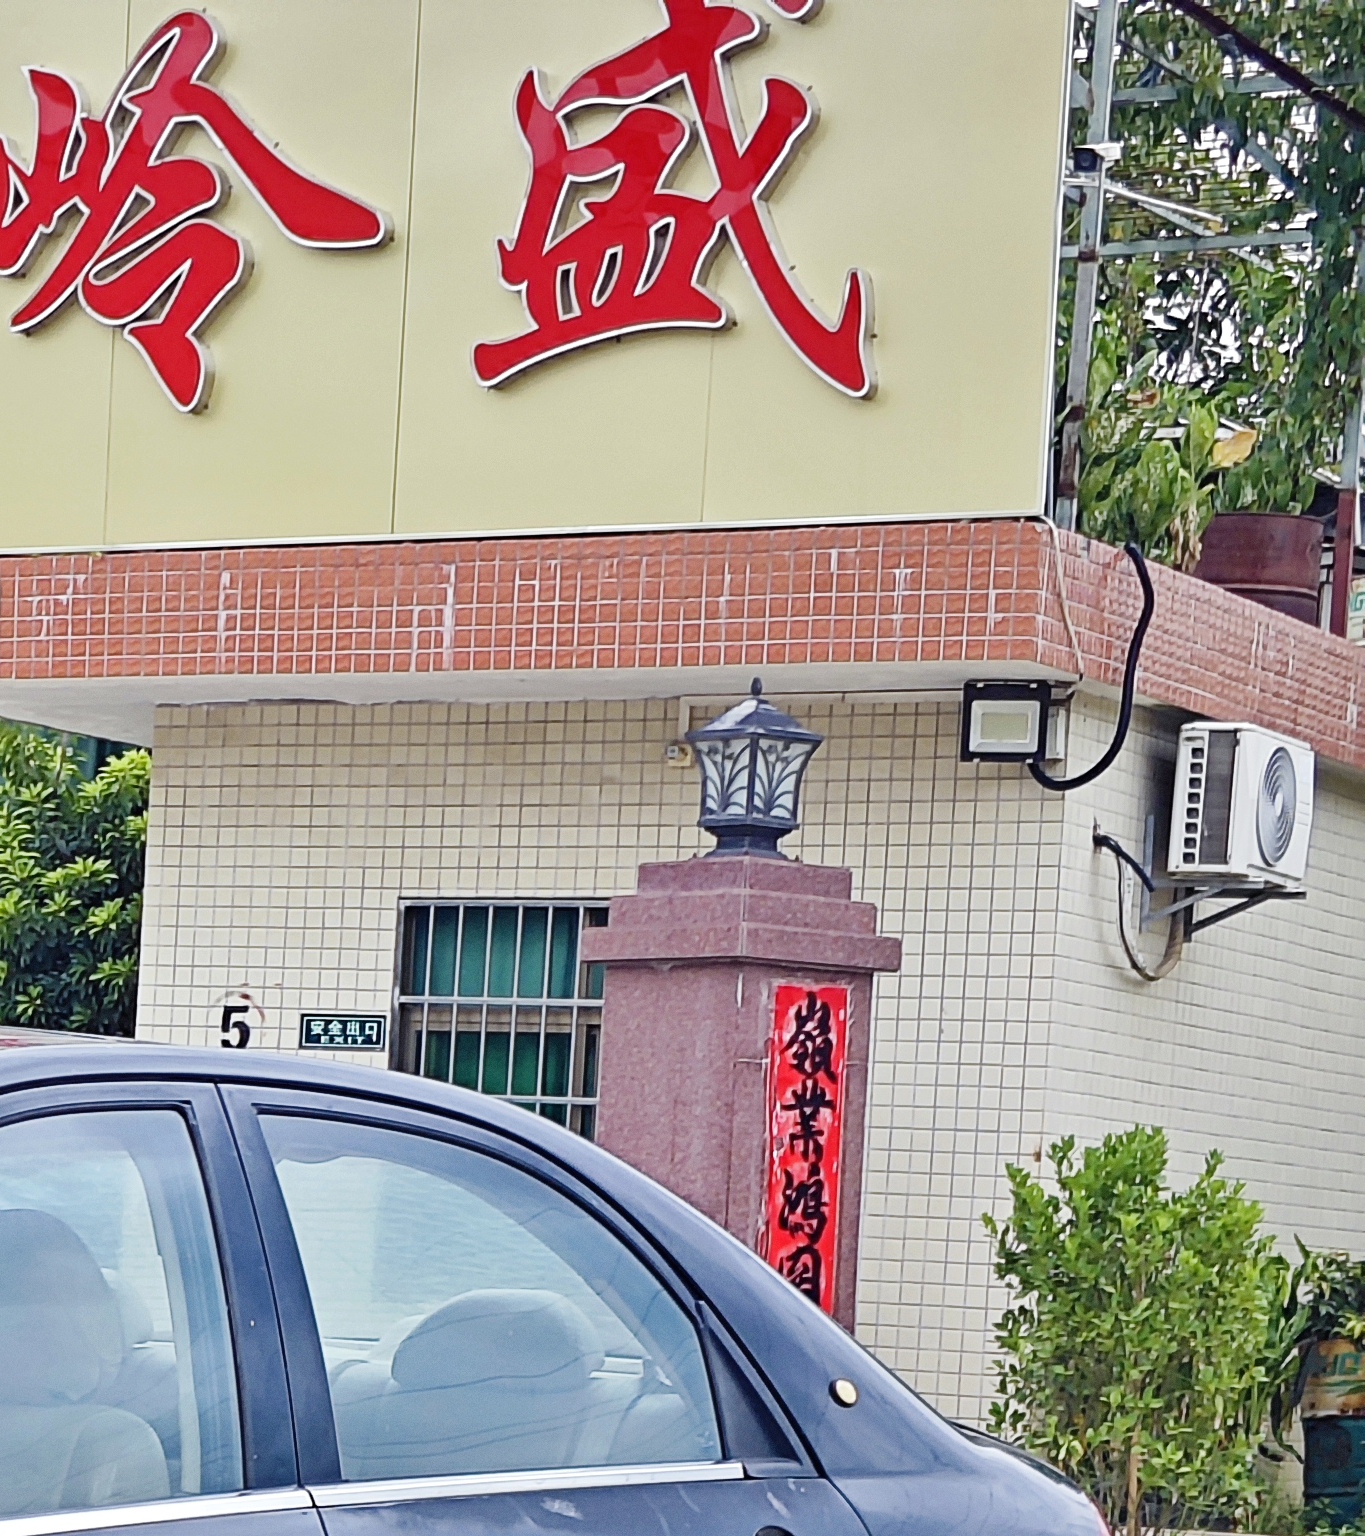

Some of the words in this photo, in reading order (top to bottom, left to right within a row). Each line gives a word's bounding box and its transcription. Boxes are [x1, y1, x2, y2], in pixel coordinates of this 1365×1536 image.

[220, 1005, 251, 1048] 5
[310, 1020, 378, 1039] 安全出口
[320, 1035, 365, 1044] EXIT
